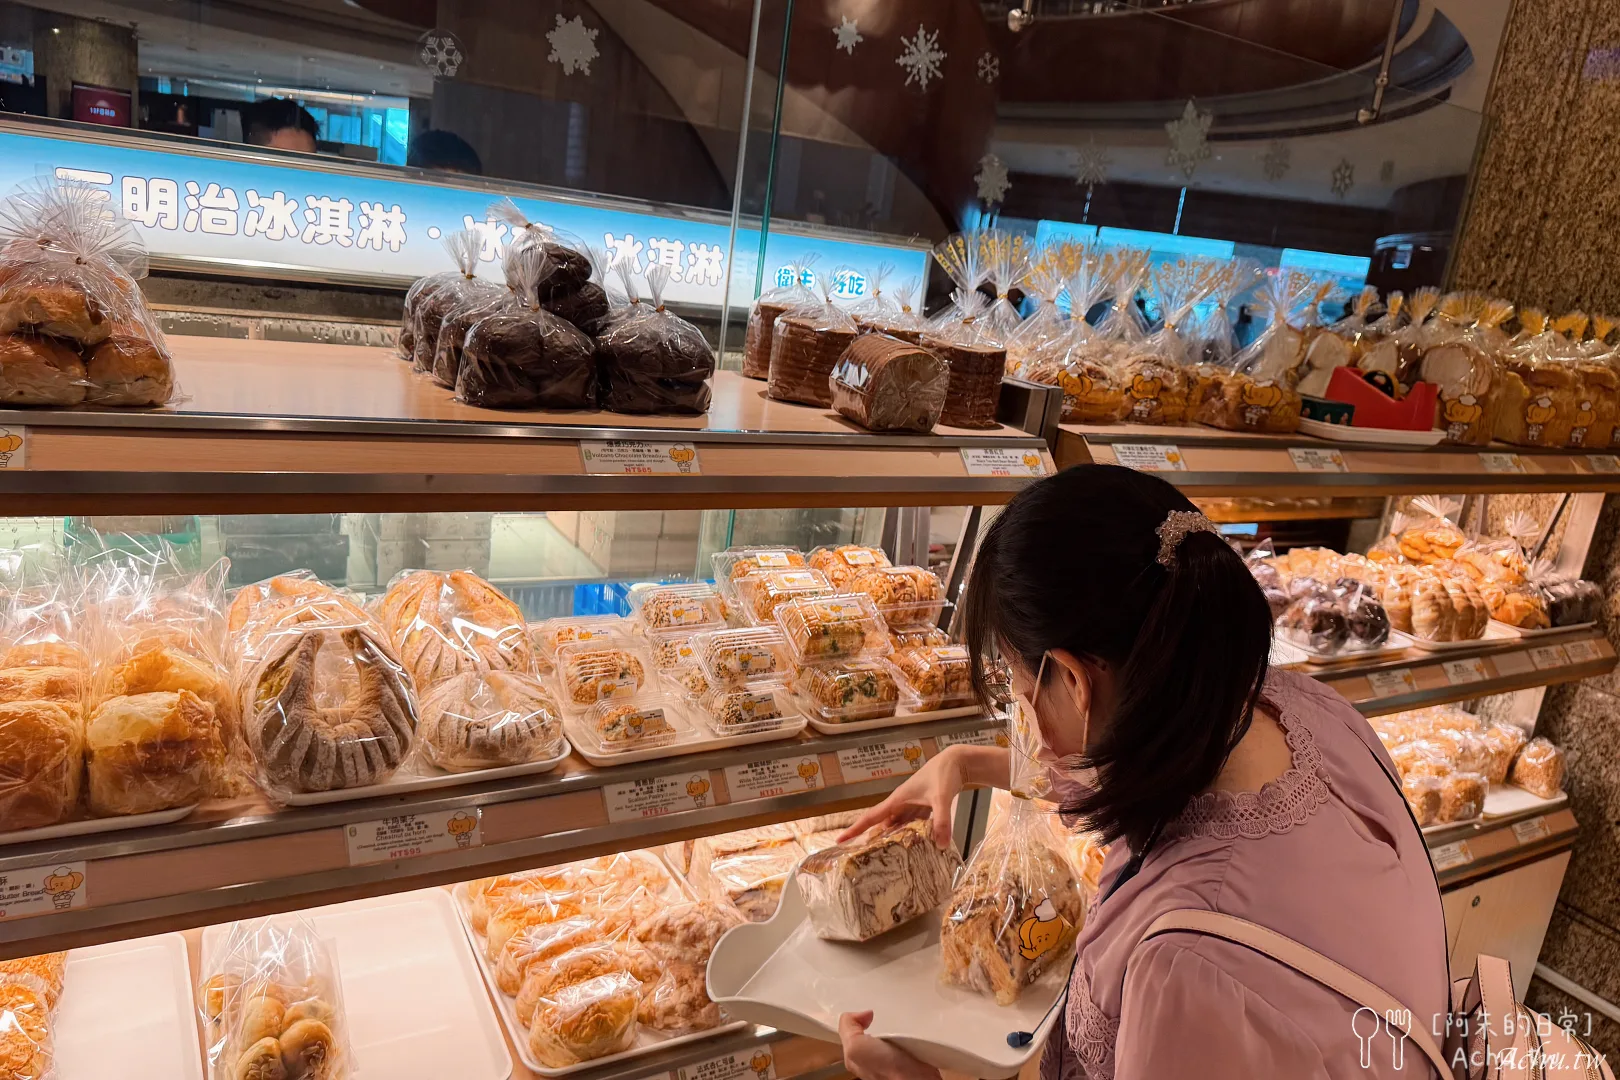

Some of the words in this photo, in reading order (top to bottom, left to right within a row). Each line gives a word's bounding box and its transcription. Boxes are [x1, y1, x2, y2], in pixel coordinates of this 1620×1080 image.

[604, 232, 724, 286] 冰淇淋
[376, 832, 403, 841] Chestnut
[390, 847, 421, 858] NT$95
[696, 1056, 735, 1073] 法式杏仁可頌
